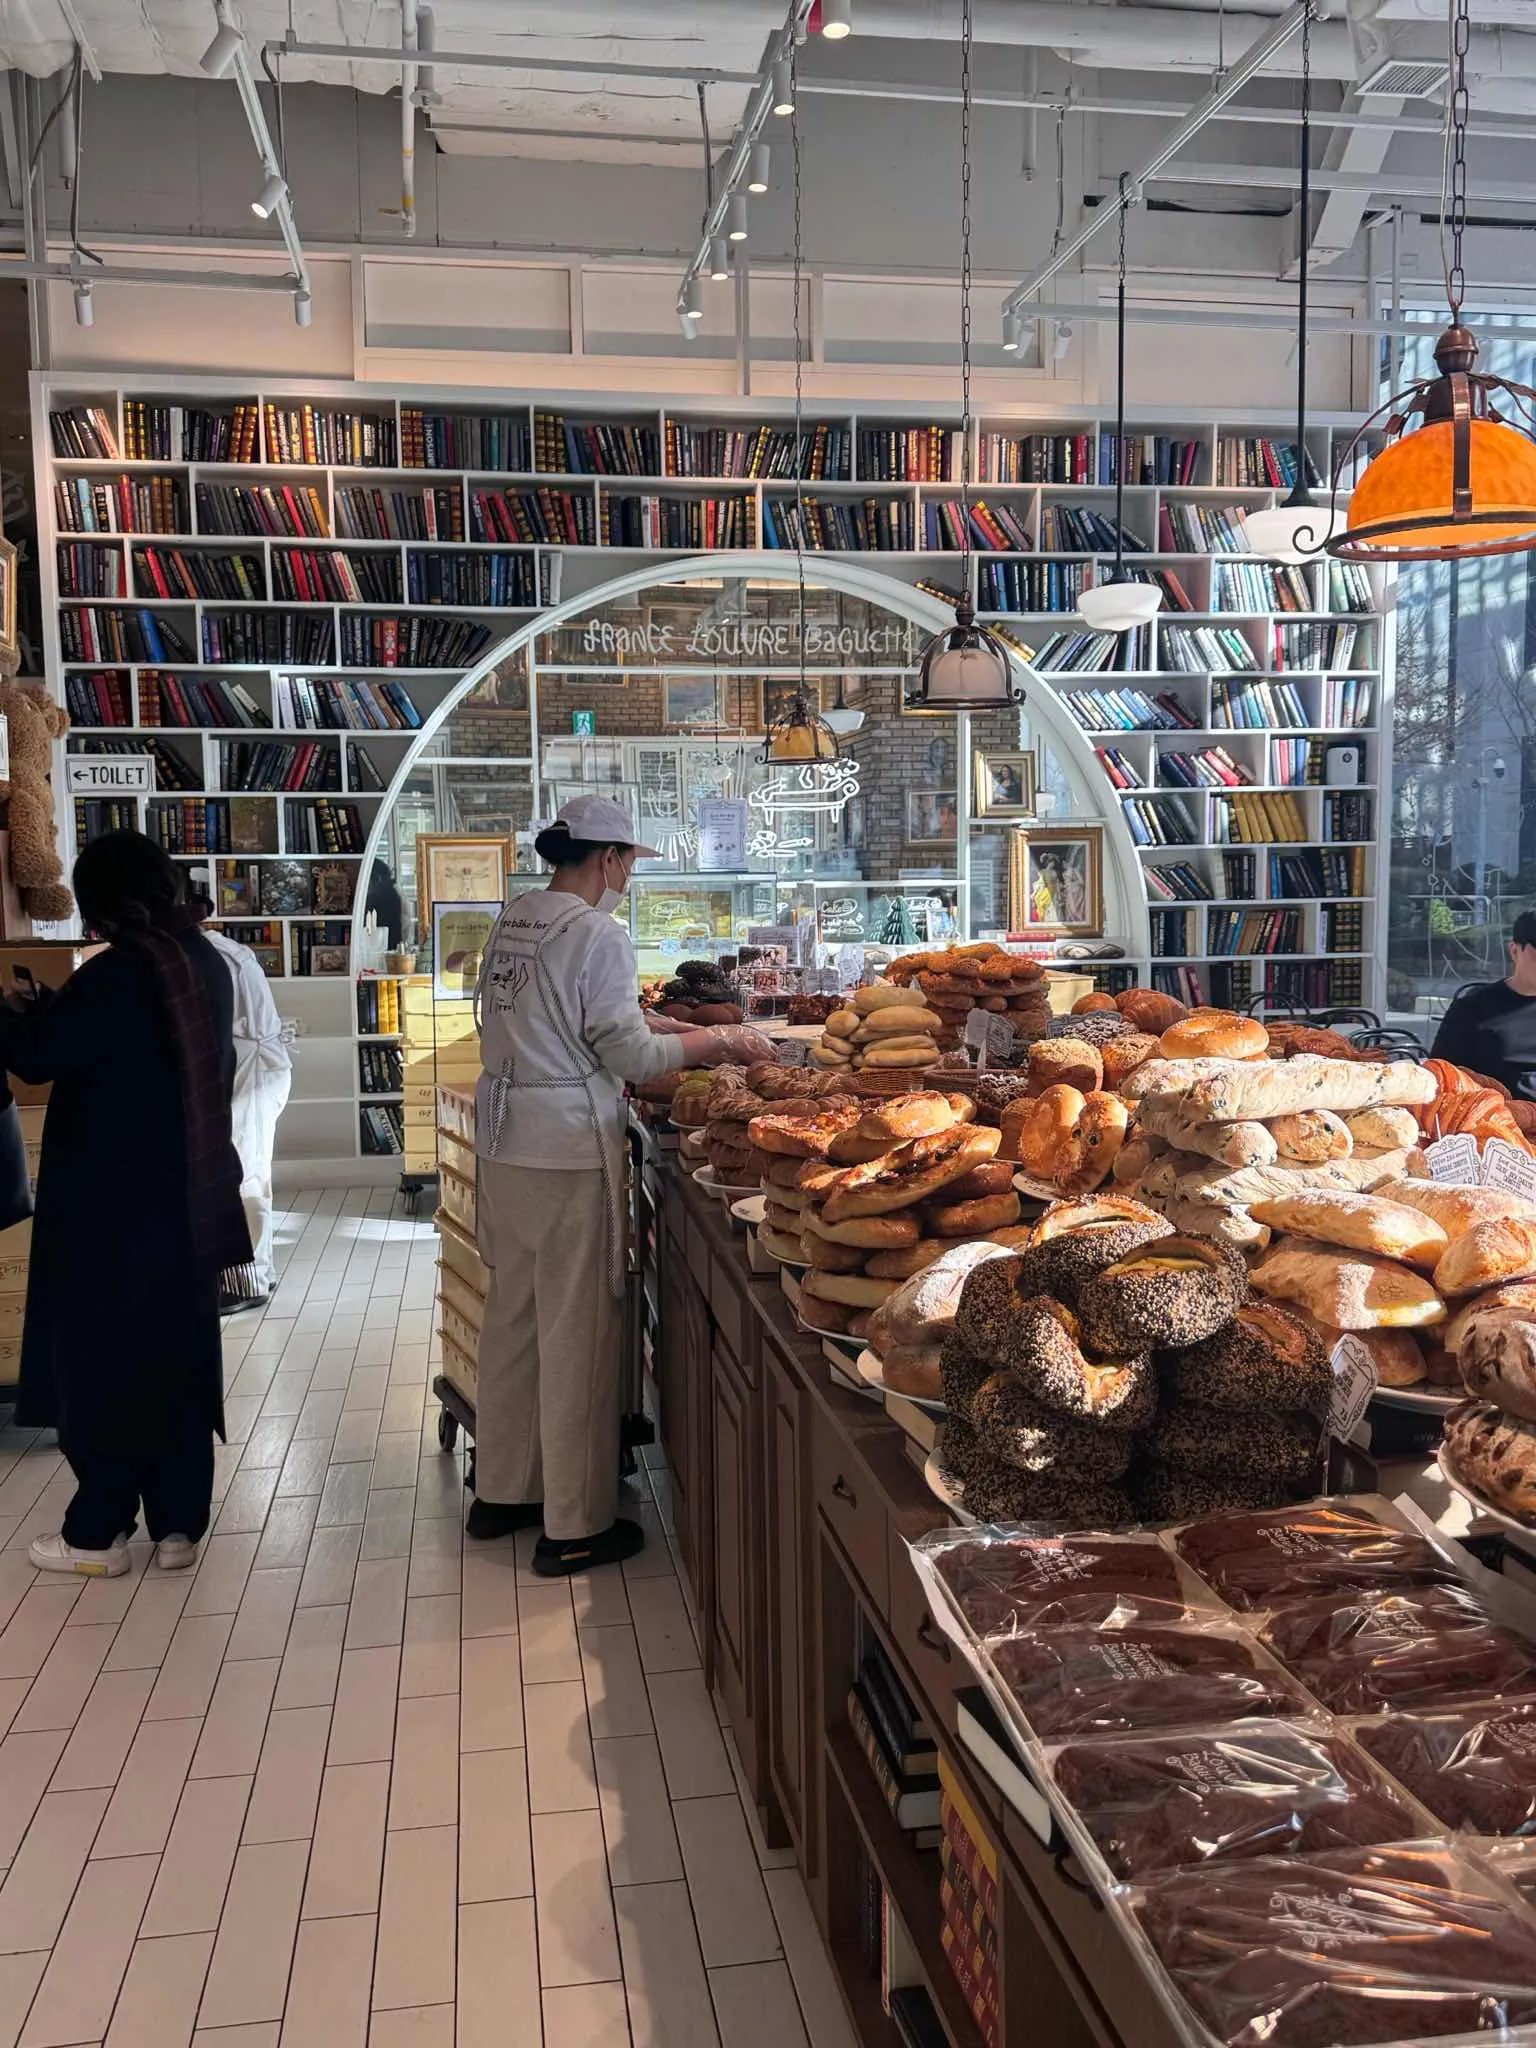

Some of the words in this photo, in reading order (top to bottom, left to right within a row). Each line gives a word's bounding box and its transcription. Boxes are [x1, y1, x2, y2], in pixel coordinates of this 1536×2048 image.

[685, 622, 789, 656] LOUVRE
[88, 766, 145, 785] TOILET
[532, 920, 547, 930] for
